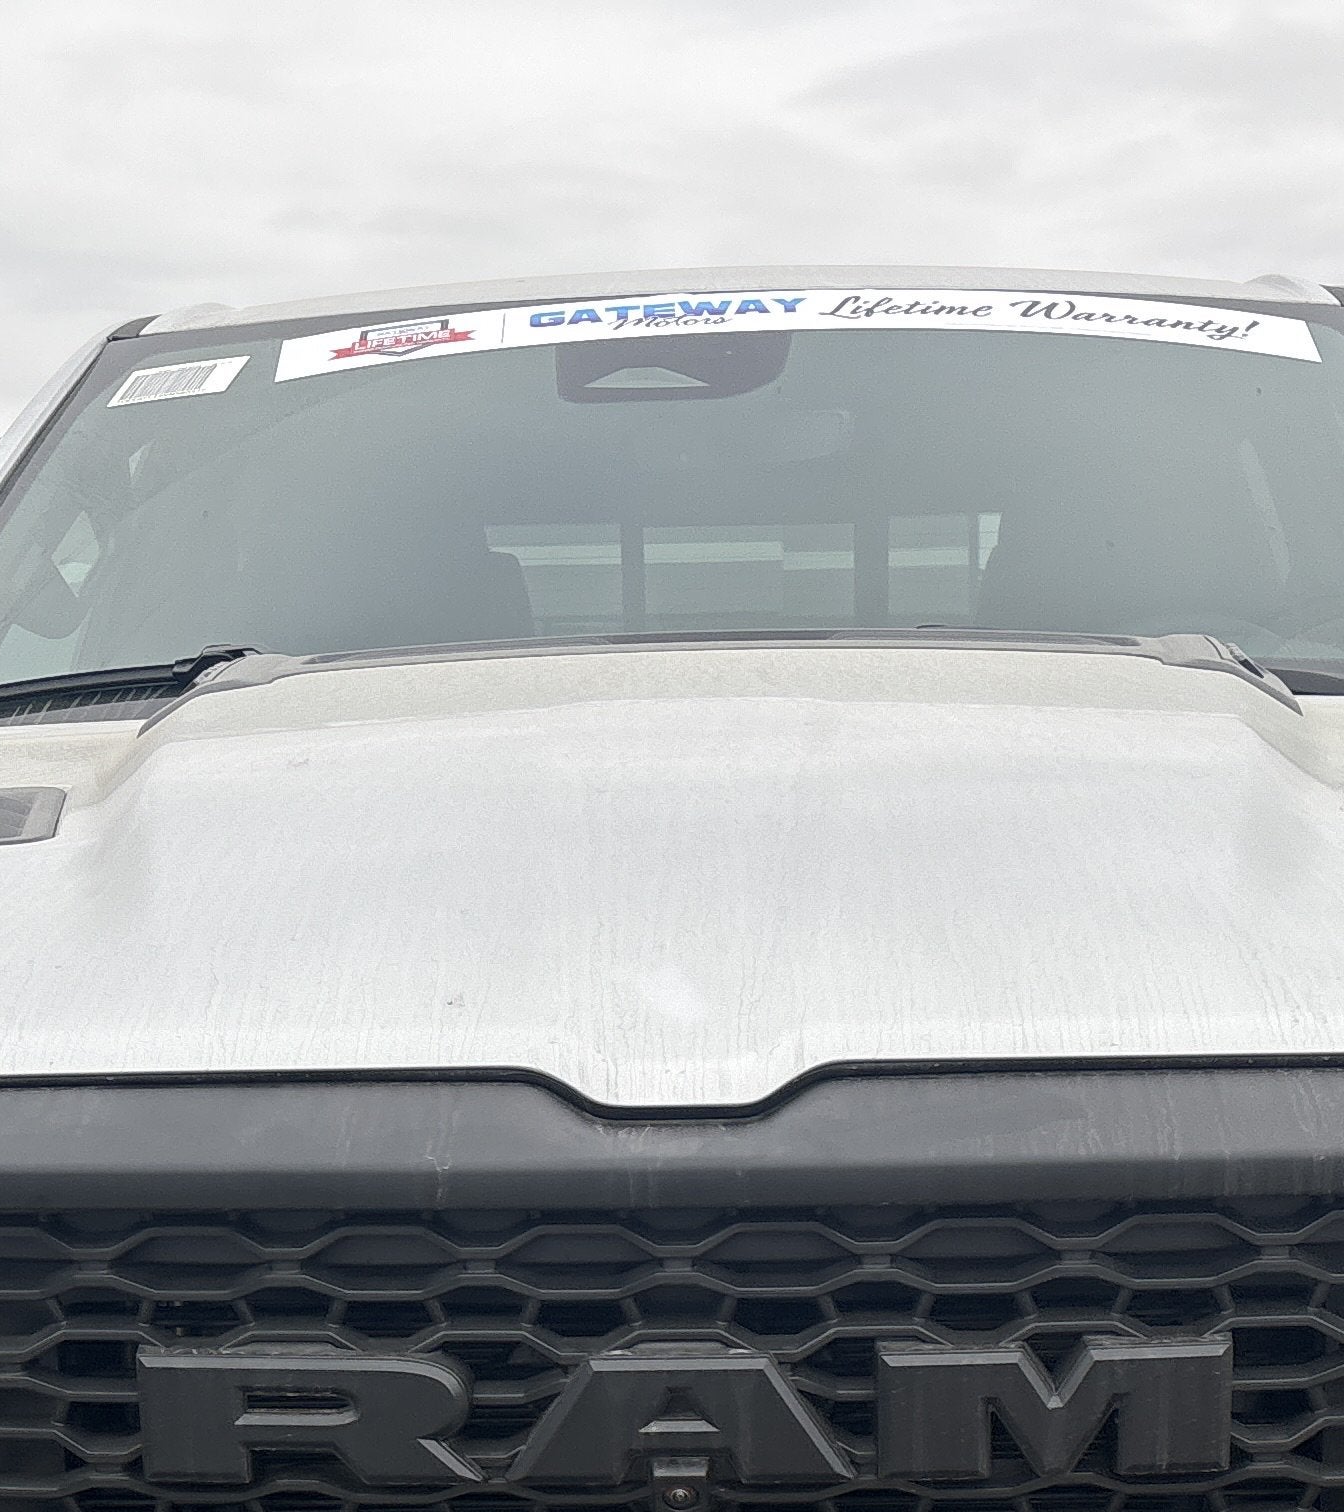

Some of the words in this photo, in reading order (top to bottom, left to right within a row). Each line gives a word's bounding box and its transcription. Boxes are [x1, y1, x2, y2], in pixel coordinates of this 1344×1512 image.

[529, 297, 807, 328] GATEWAY
[607, 313, 733, 331] Motors
[819, 294, 994, 320] Lifetime
[1008, 299, 1260, 341] Warranty!
[354, 329, 452, 351] LIFETIME
[137, 1339, 1233, 1484] RAM
